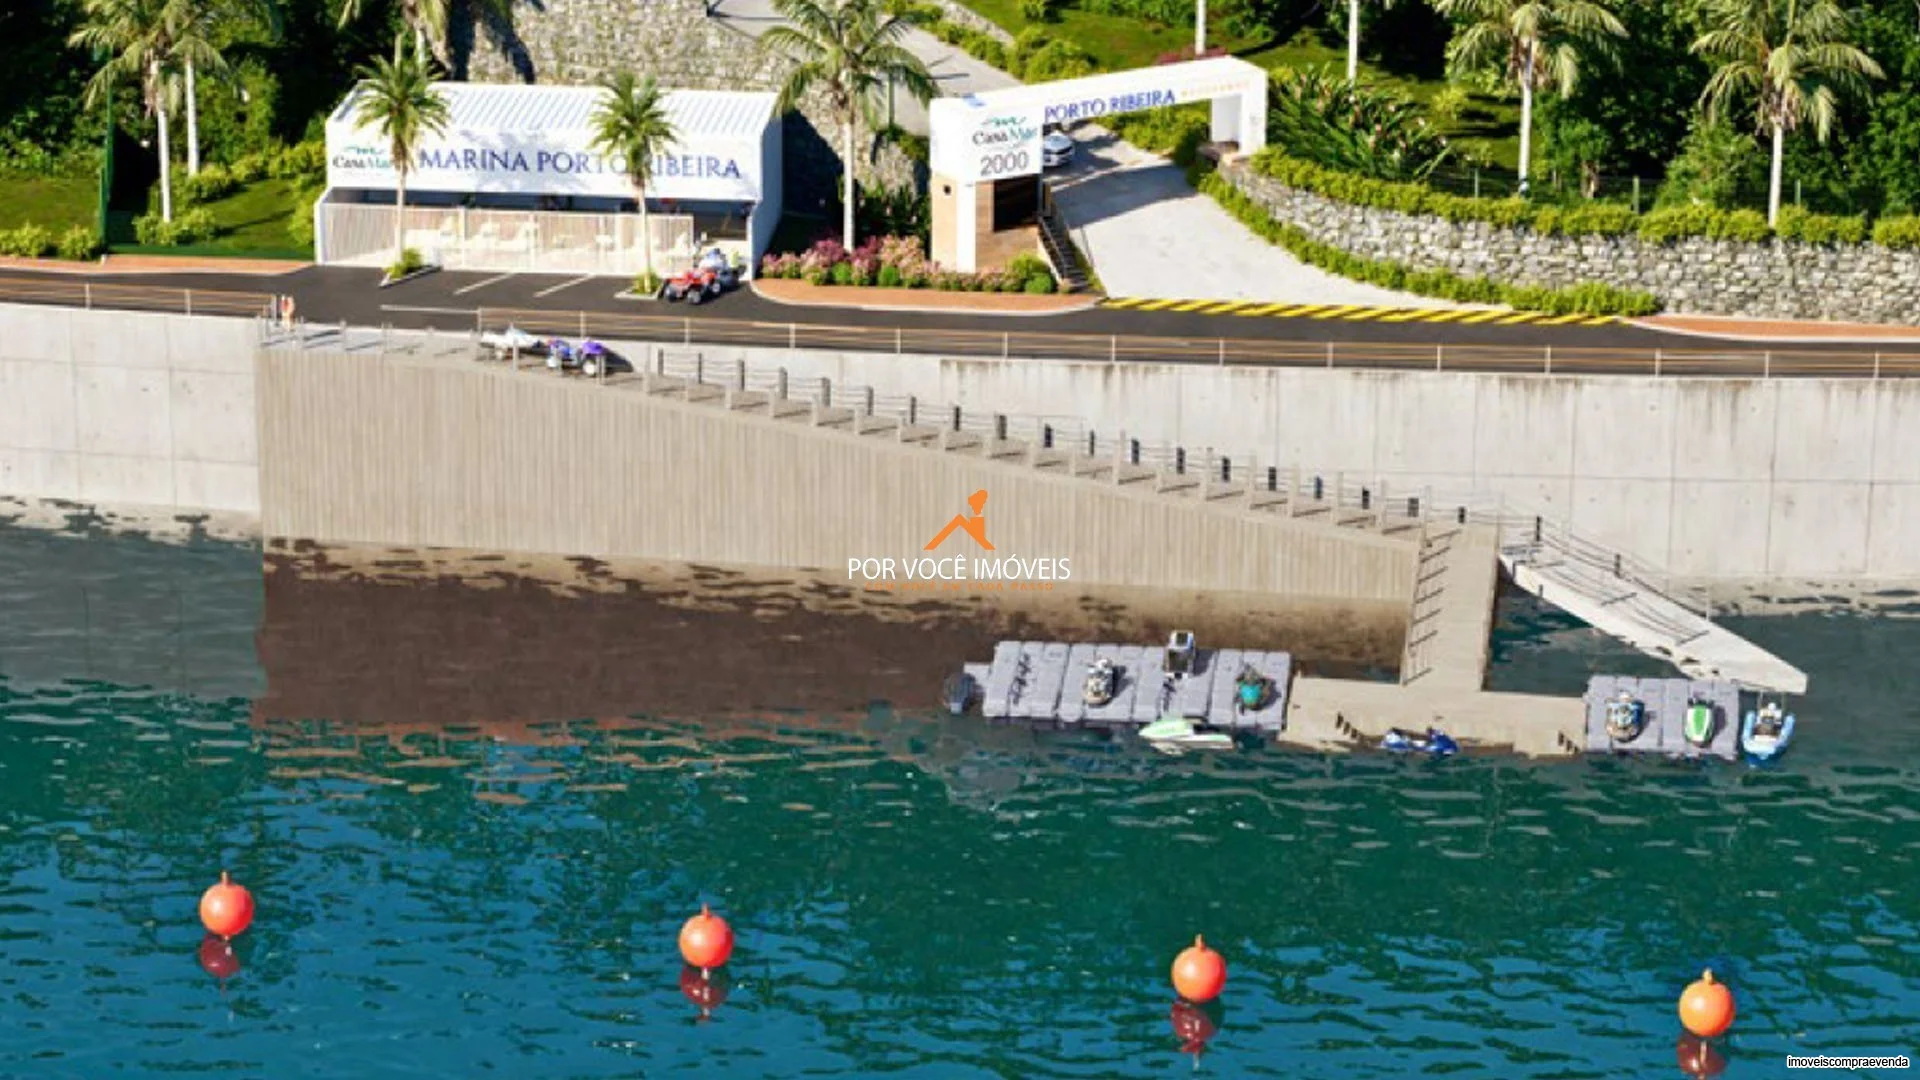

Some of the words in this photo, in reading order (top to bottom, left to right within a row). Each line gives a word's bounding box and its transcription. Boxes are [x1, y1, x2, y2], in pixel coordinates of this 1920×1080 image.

[1044, 98, 1107, 123] PORTO
[1109, 89, 1176, 112] RIBEIRA
[419, 148, 530, 173] MARINA
[537, 151, 631, 174] PORTO
[646, 154, 741, 179] IBEIRA
[980, 150, 1030, 177] 2000
